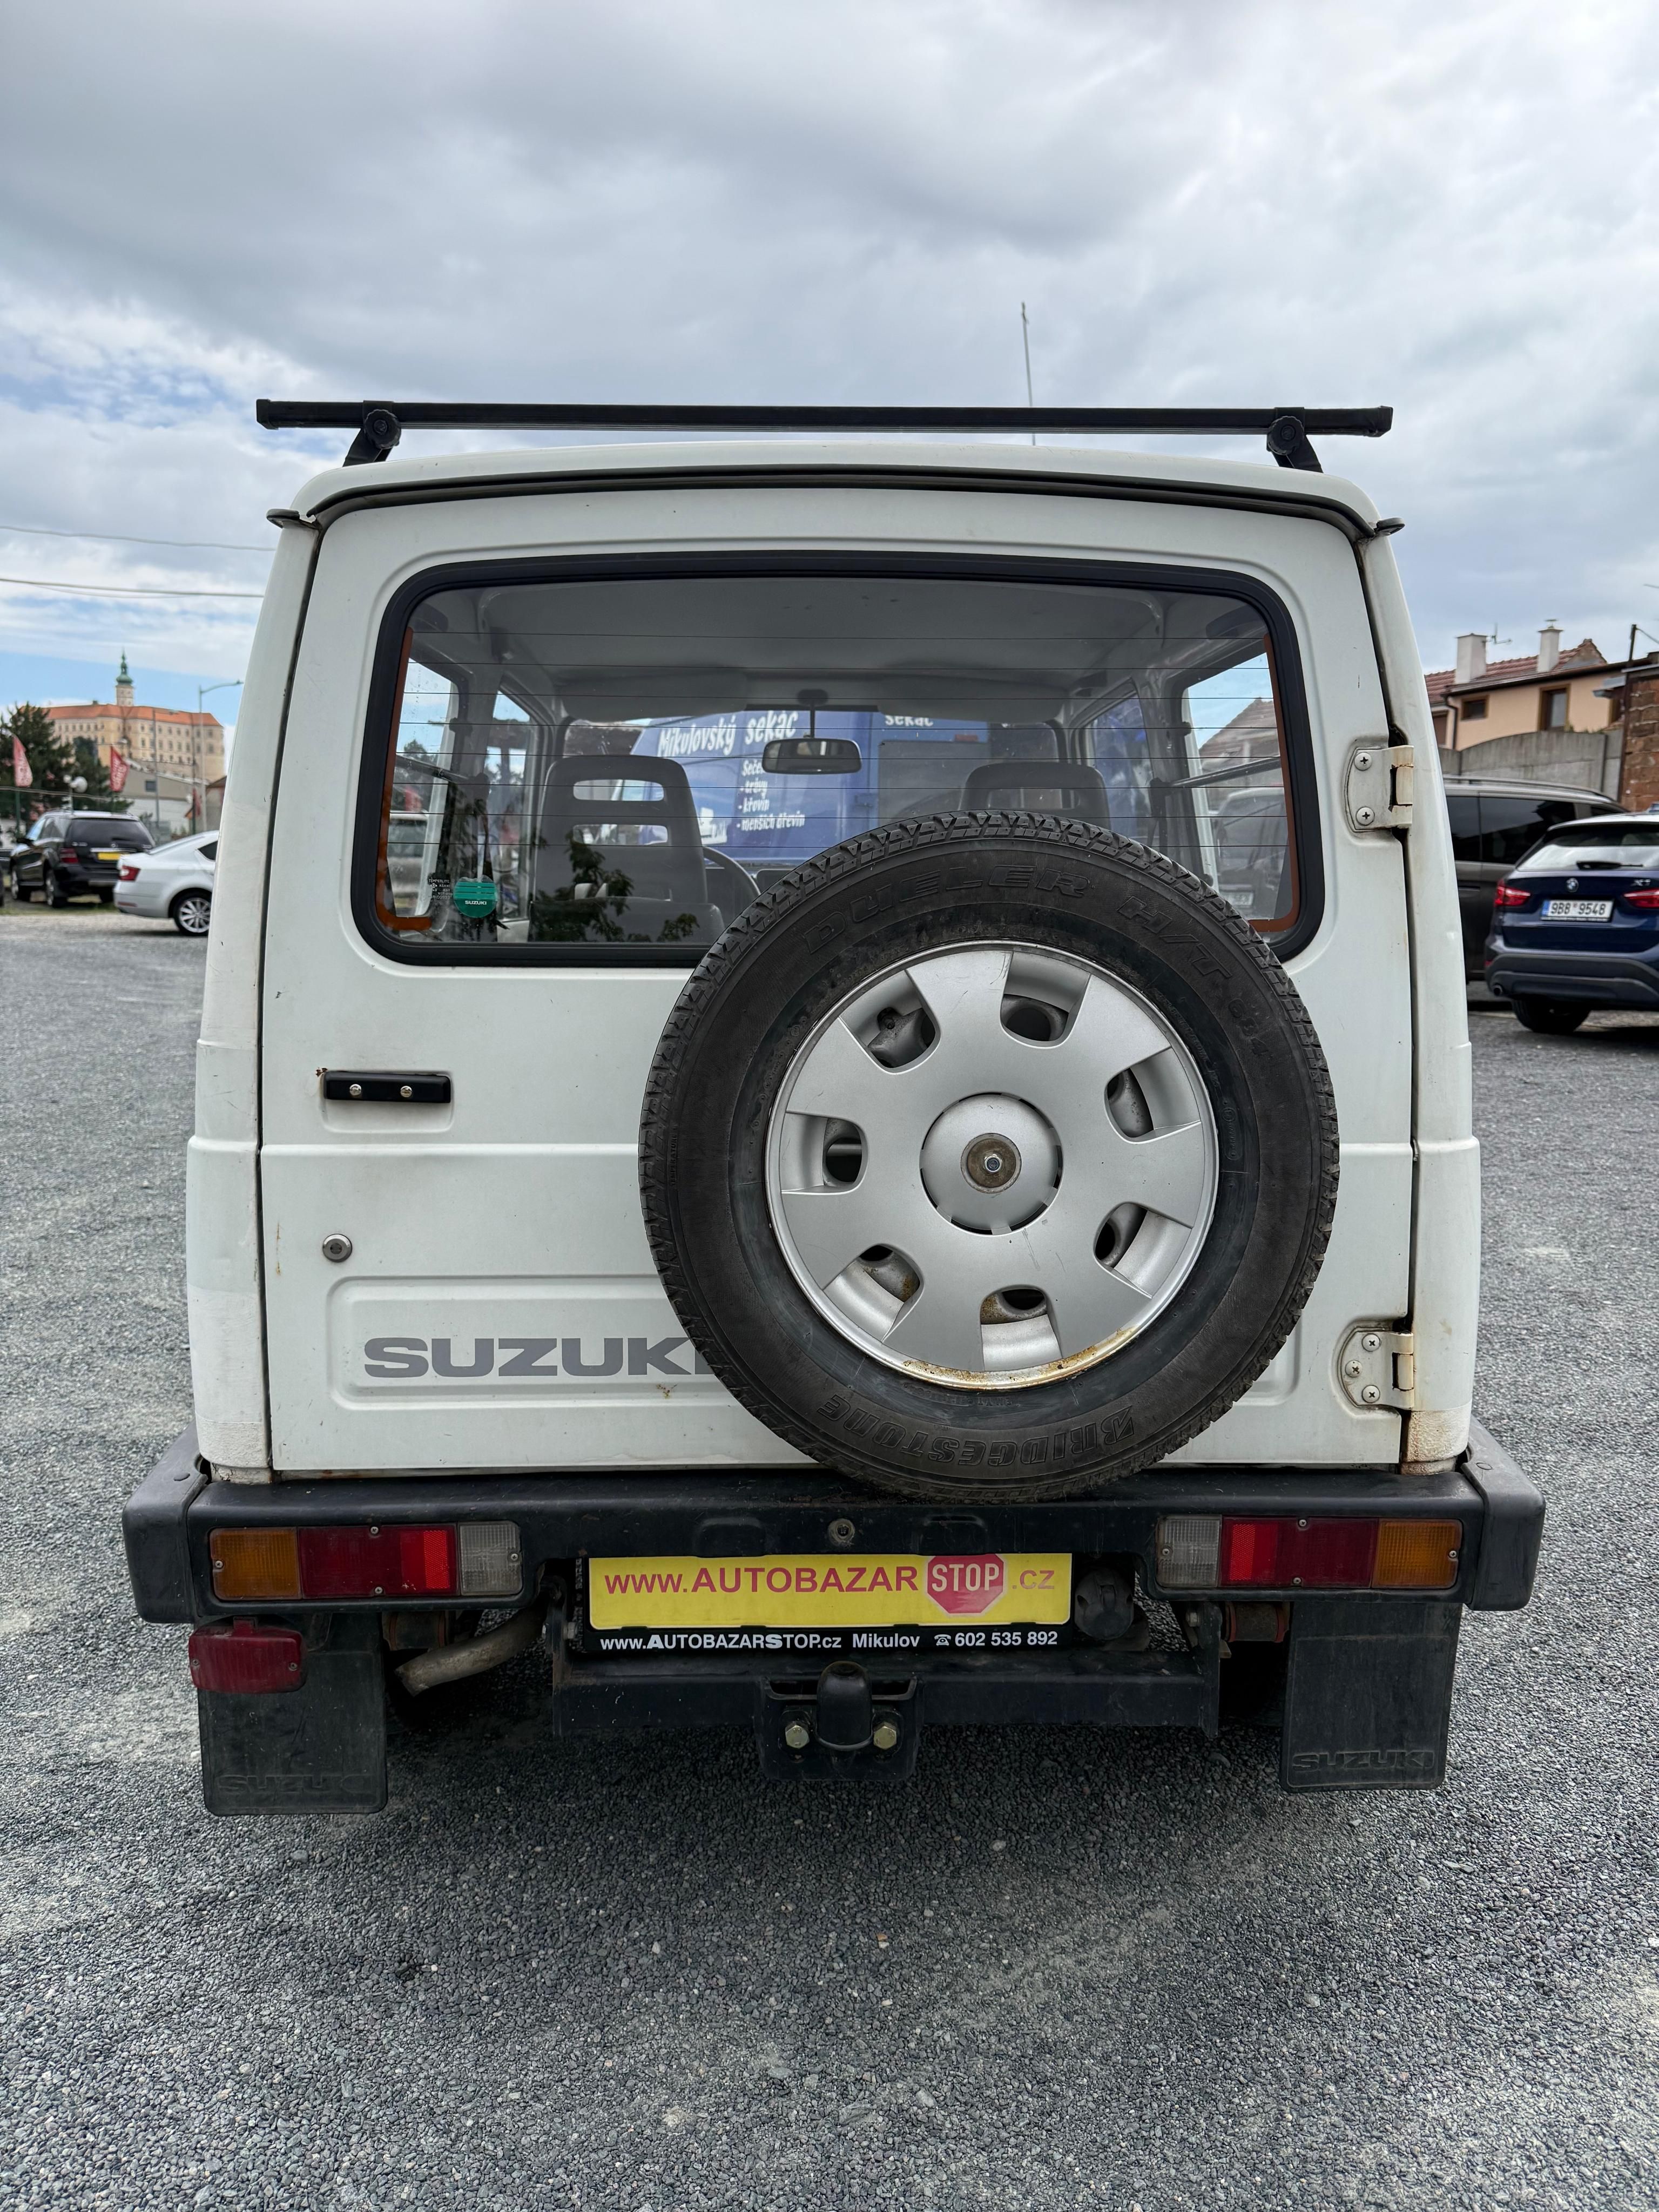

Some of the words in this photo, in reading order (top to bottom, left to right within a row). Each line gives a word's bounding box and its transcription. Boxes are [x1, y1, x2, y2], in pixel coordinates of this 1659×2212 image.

[657, 715, 736, 756] Mikulovský
[816, 1393, 1136, 1467] BRIDGESTONE
[852, 1632, 920, 1648] Mikulov
[955, 1632, 986, 1647] 602
[991, 1631, 1022, 1645] 535
[1027, 1630, 1058, 1645] 892
[1293, 1749, 1435, 1773] SUZUKI
